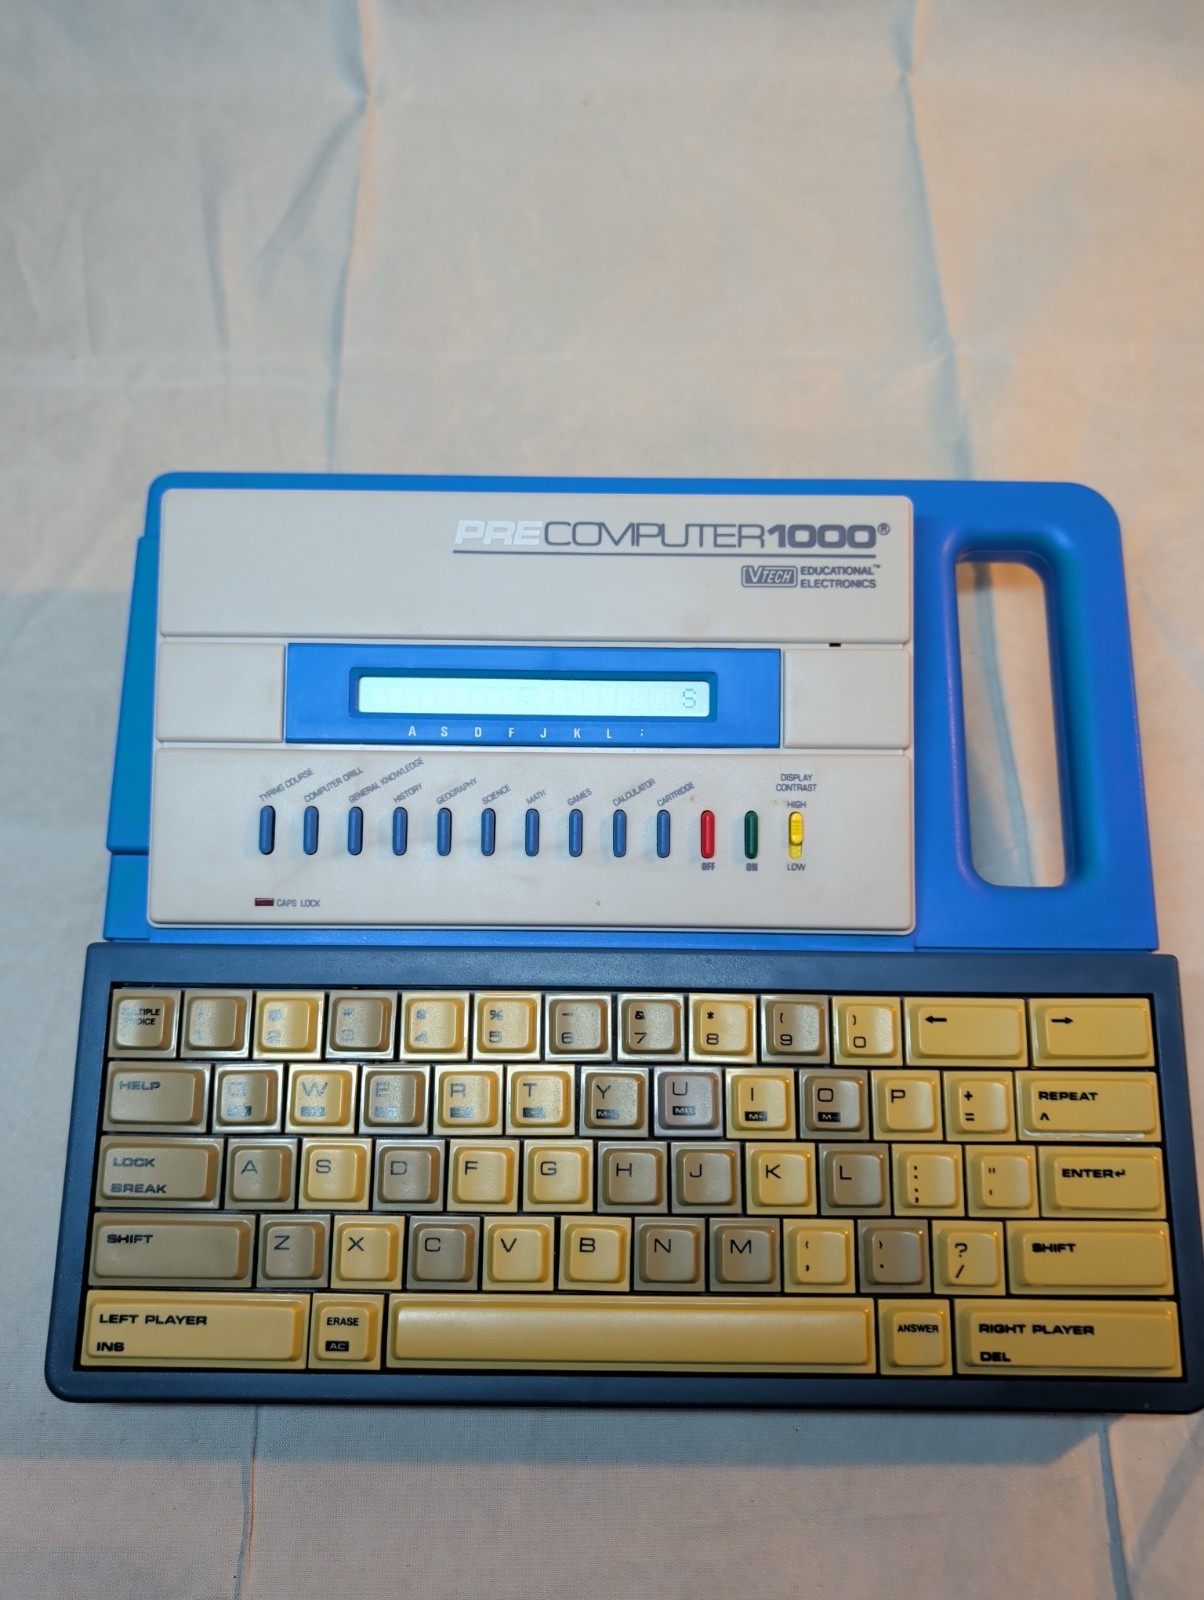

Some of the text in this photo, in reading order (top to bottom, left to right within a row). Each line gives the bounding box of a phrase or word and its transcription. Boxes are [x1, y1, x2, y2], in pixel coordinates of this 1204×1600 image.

[744, 564, 795, 585] VTECH
[799, 578, 877, 589] ELECTRONICS
[682, 688, 697, 709] S
[408, 725, 417, 737] A
[440, 726, 448, 738] S
[474, 726, 482, 738] D
[508, 727, 515, 738] F
[540, 728, 547, 739] J
[573, 727, 582, 739] K
[606, 728, 613, 739] L
[259, 768, 314, 802] TYPING COURSE
[303, 767, 364, 803] COMPUTER DRILL
[348, 757, 424, 804] GENERAL KNOWLEDGE
[780, 773, 812, 783] DISPLAY
[392, 783, 423, 804] HISTORY
[435, 777, 477, 805] GEOGRAPHY
[481, 784, 511, 805] SCIENCE
[612, 777, 656, 807] CALCULATOR
[656, 781, 696, 807] CARTRIDGE
[776, 783, 817, 793] CONTRAST
[526, 789, 547, 804] MATH
[567, 788, 593, 806] GAMES
[787, 801, 806, 809] HIGH
[787, 863, 806, 872] LOW
[277, 899, 321, 908] CAPS LOCK
[634, 1010, 645, 1020] &
[489, 1030, 503, 1044] 5
[561, 1031, 574, 1045] 6
[634, 1031, 648, 1045] 7
[706, 1033, 719, 1046] 8
[780, 1034, 793, 1047] 9
[119, 1080, 161, 1091] HELP
[301, 1081, 328, 1097] W
[375, 1081, 390, 1098] E
[450, 1083, 467, 1098] R
[522, 1083, 538, 1098] T
[596, 1084, 612, 1099] Y
[672, 1081, 688, 1097] U
[817, 1088, 834, 1102] O
[891, 1089, 906, 1103] P
[964, 1090, 973, 1101] +
[1038, 1091, 1098, 1101] REPEAT
[965, 1112, 975, 1121] =
[112, 1157, 156, 1168] LOCK
[240, 1160, 259, 1174] A
[315, 1159, 332, 1174] S
[390, 1160, 408, 1176] D
[464, 1160, 478, 1175] F
[540, 1161, 557, 1176] G
[615, 1162, 633, 1178] H
[689, 1163, 703, 1178] J
[765, 1164, 782, 1180] K
[839, 1165, 852, 1180] L
[110, 1183, 167, 1194] BREAK
[106, 1233, 153, 1244] SHIFT
[274, 1235, 290, 1250] Z
[347, 1236, 364, 1252] X
[425, 1237, 441, 1252] C
[501, 1238, 517, 1253] V
[580, 1238, 596, 1253] B
[654, 1238, 671, 1254] N
[730, 1239, 752, 1255] M
[955, 1243, 968, 1257] ?
[1032, 1243, 1076, 1253] SHIFT
[955, 1264, 965, 1279] /
[99, 1314, 207, 1325] LEFT PLAYER
[326, 1317, 359, 1326] ERASE
[897, 1323, 939, 1333] ANSWER
[979, 1324, 1095, 1335] RIGHT PLAYER
[97, 1341, 125, 1352] INS
[979, 1351, 1012, 1362] DEL
